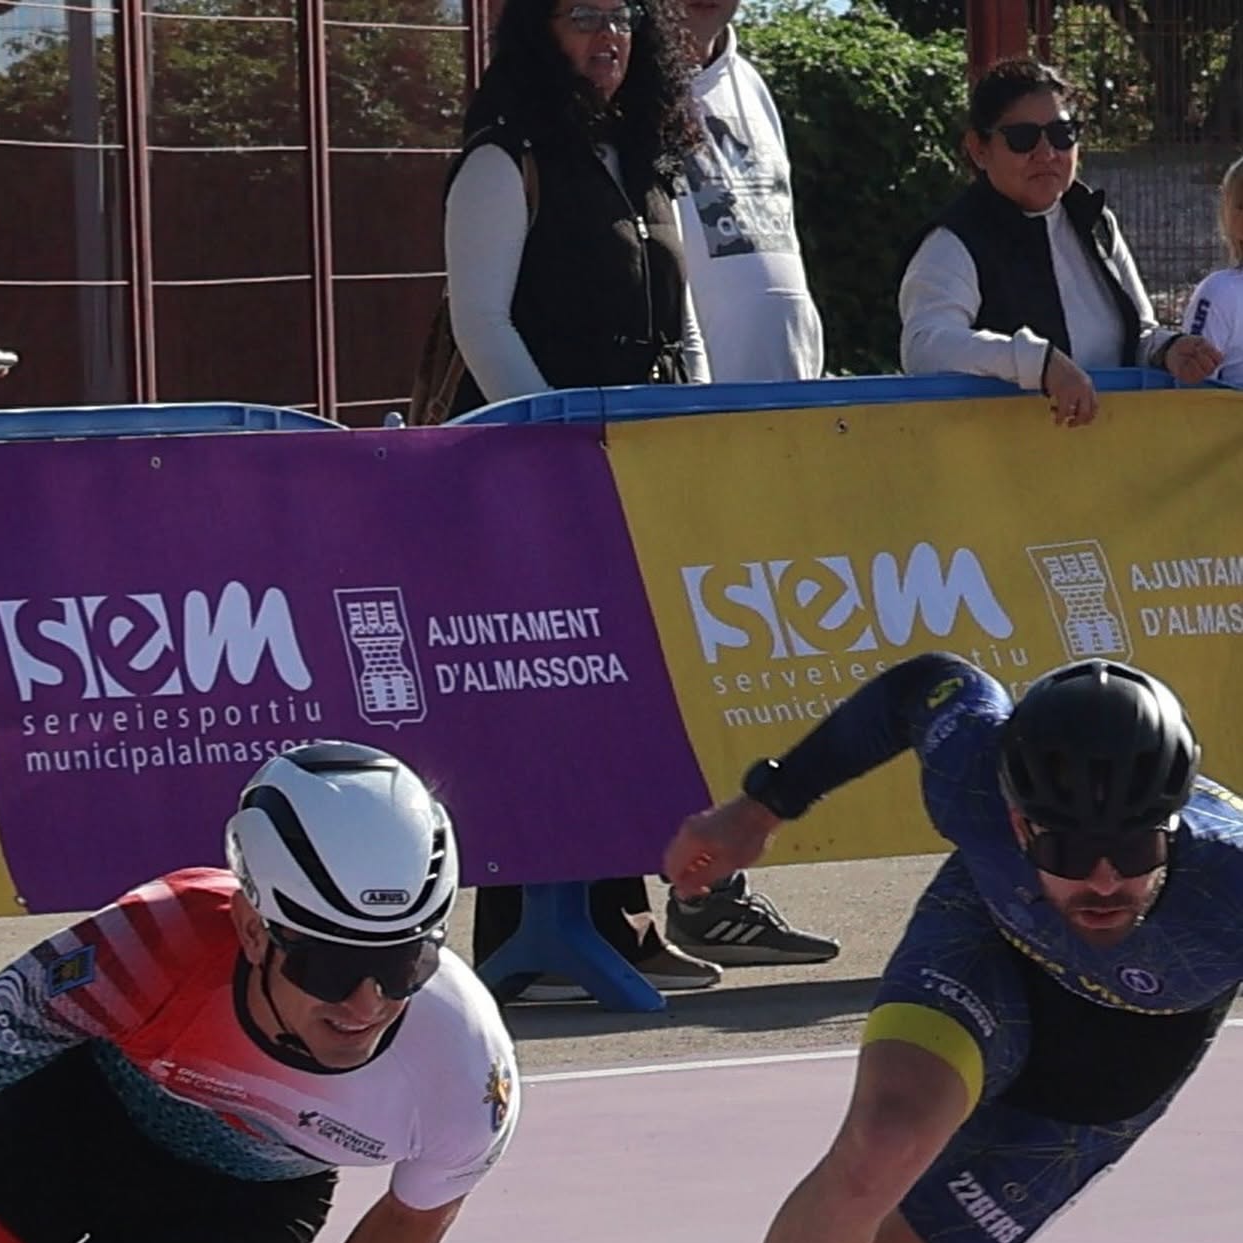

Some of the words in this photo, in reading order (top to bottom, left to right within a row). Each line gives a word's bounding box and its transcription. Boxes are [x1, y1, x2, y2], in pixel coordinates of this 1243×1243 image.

[428, 607, 601, 647] AJUNTAMENT
[435, 653, 628, 694] D'ALMASSORA
[22, 697, 322, 736] serveiesportiu
